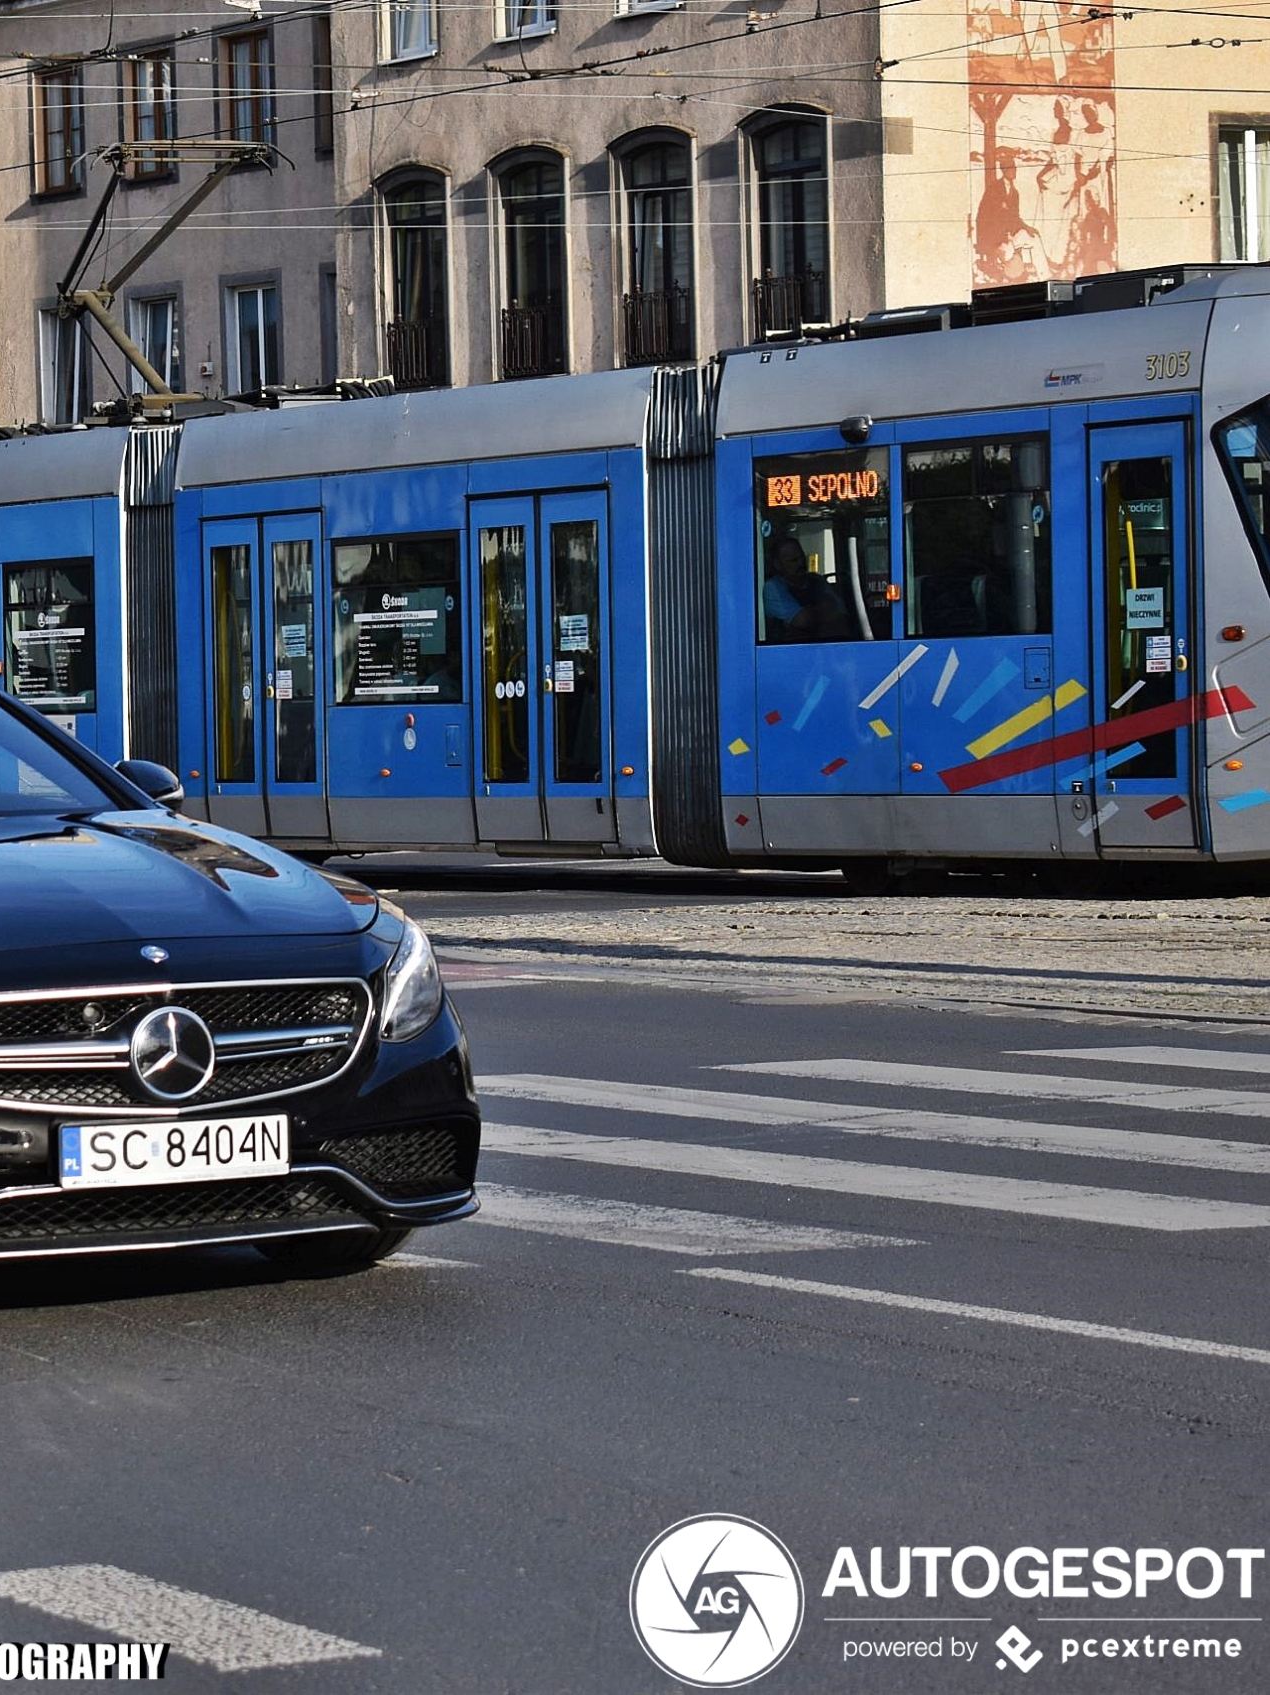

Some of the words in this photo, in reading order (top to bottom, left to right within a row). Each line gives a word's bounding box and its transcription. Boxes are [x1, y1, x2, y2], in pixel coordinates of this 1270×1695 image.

[1145, 350, 1191, 381] 3103
[1060, 373, 1082, 387] MPK
[772, 477, 795, 504] 33
[1135, 593, 1155, 603] DRZWI
[1129, 609, 1161, 619] NIECZYNNE
[90, 1129, 148, 1172] SC
[166, 1120, 281, 1168] 8404N
[64, 1159, 80, 1170] PL
